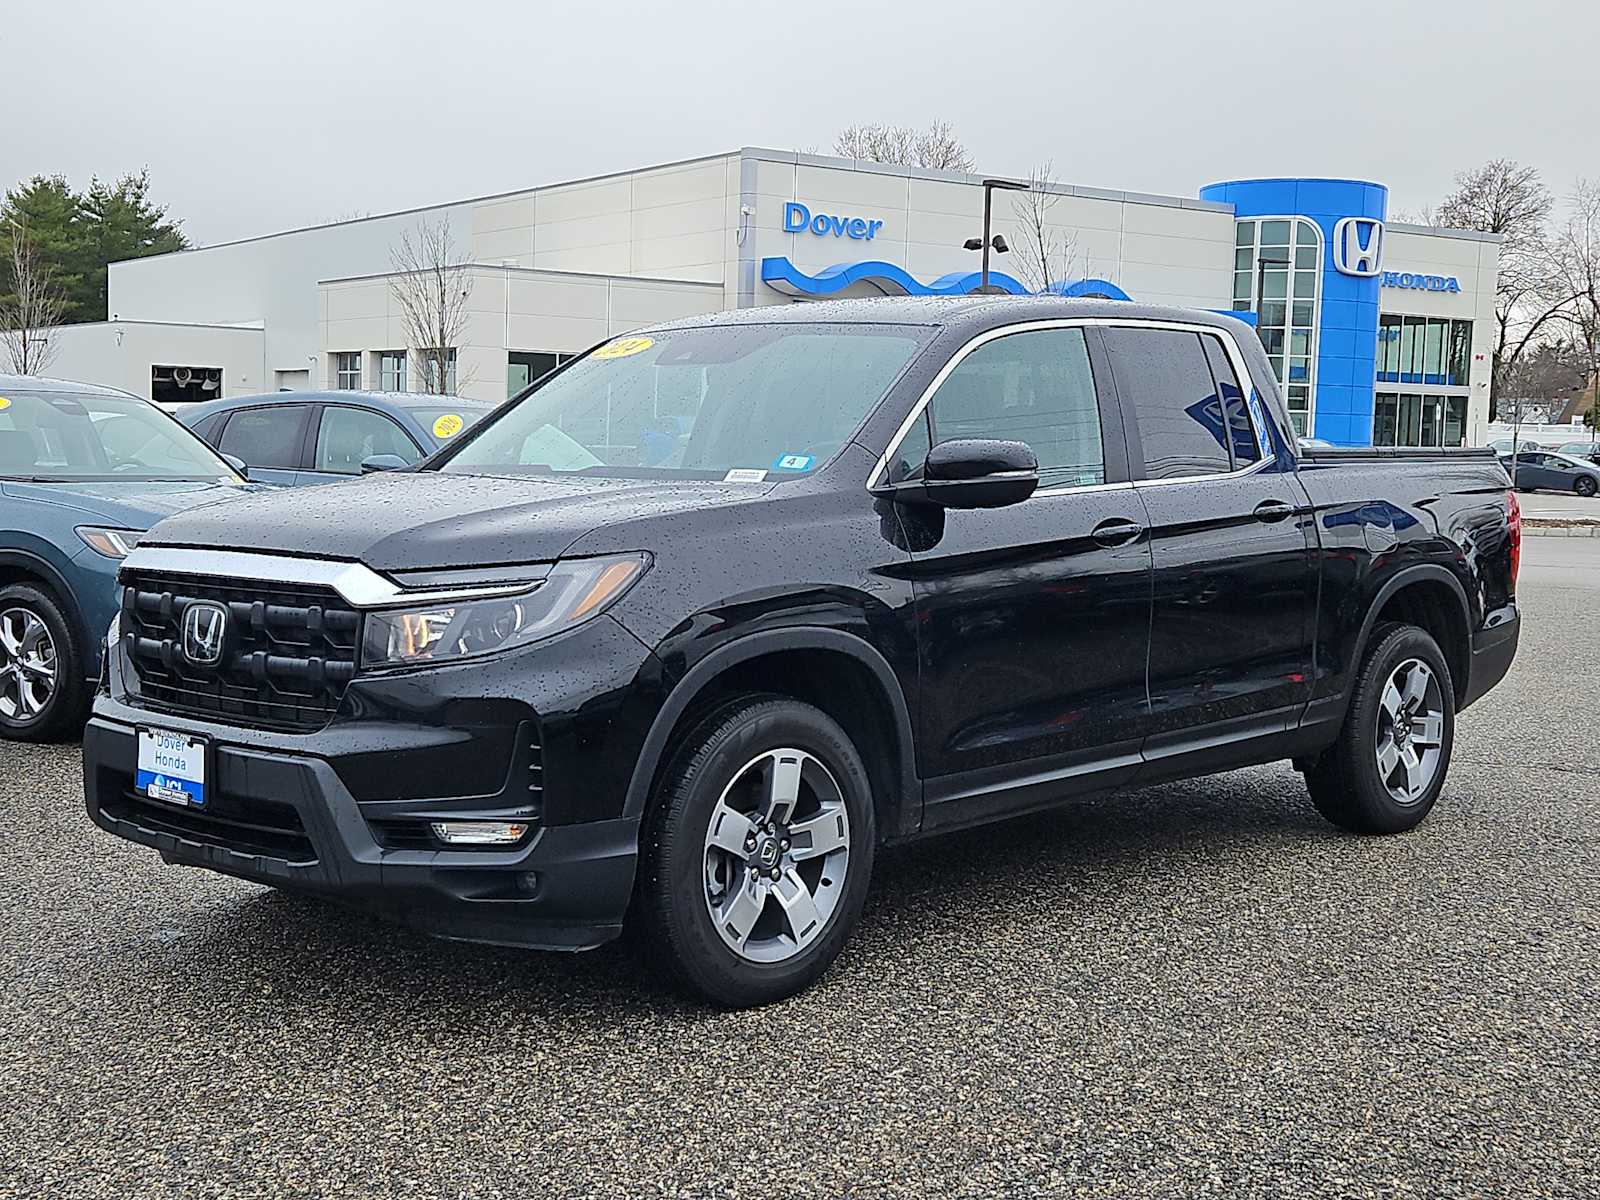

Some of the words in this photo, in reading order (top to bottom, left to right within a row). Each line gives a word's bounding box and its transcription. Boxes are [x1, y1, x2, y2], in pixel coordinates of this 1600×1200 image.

[783, 202, 884, 240] Dover
[1382, 271, 1462, 293] HONDA
[156, 734, 185, 752] Dover
[155, 751, 187, 770] Honda
